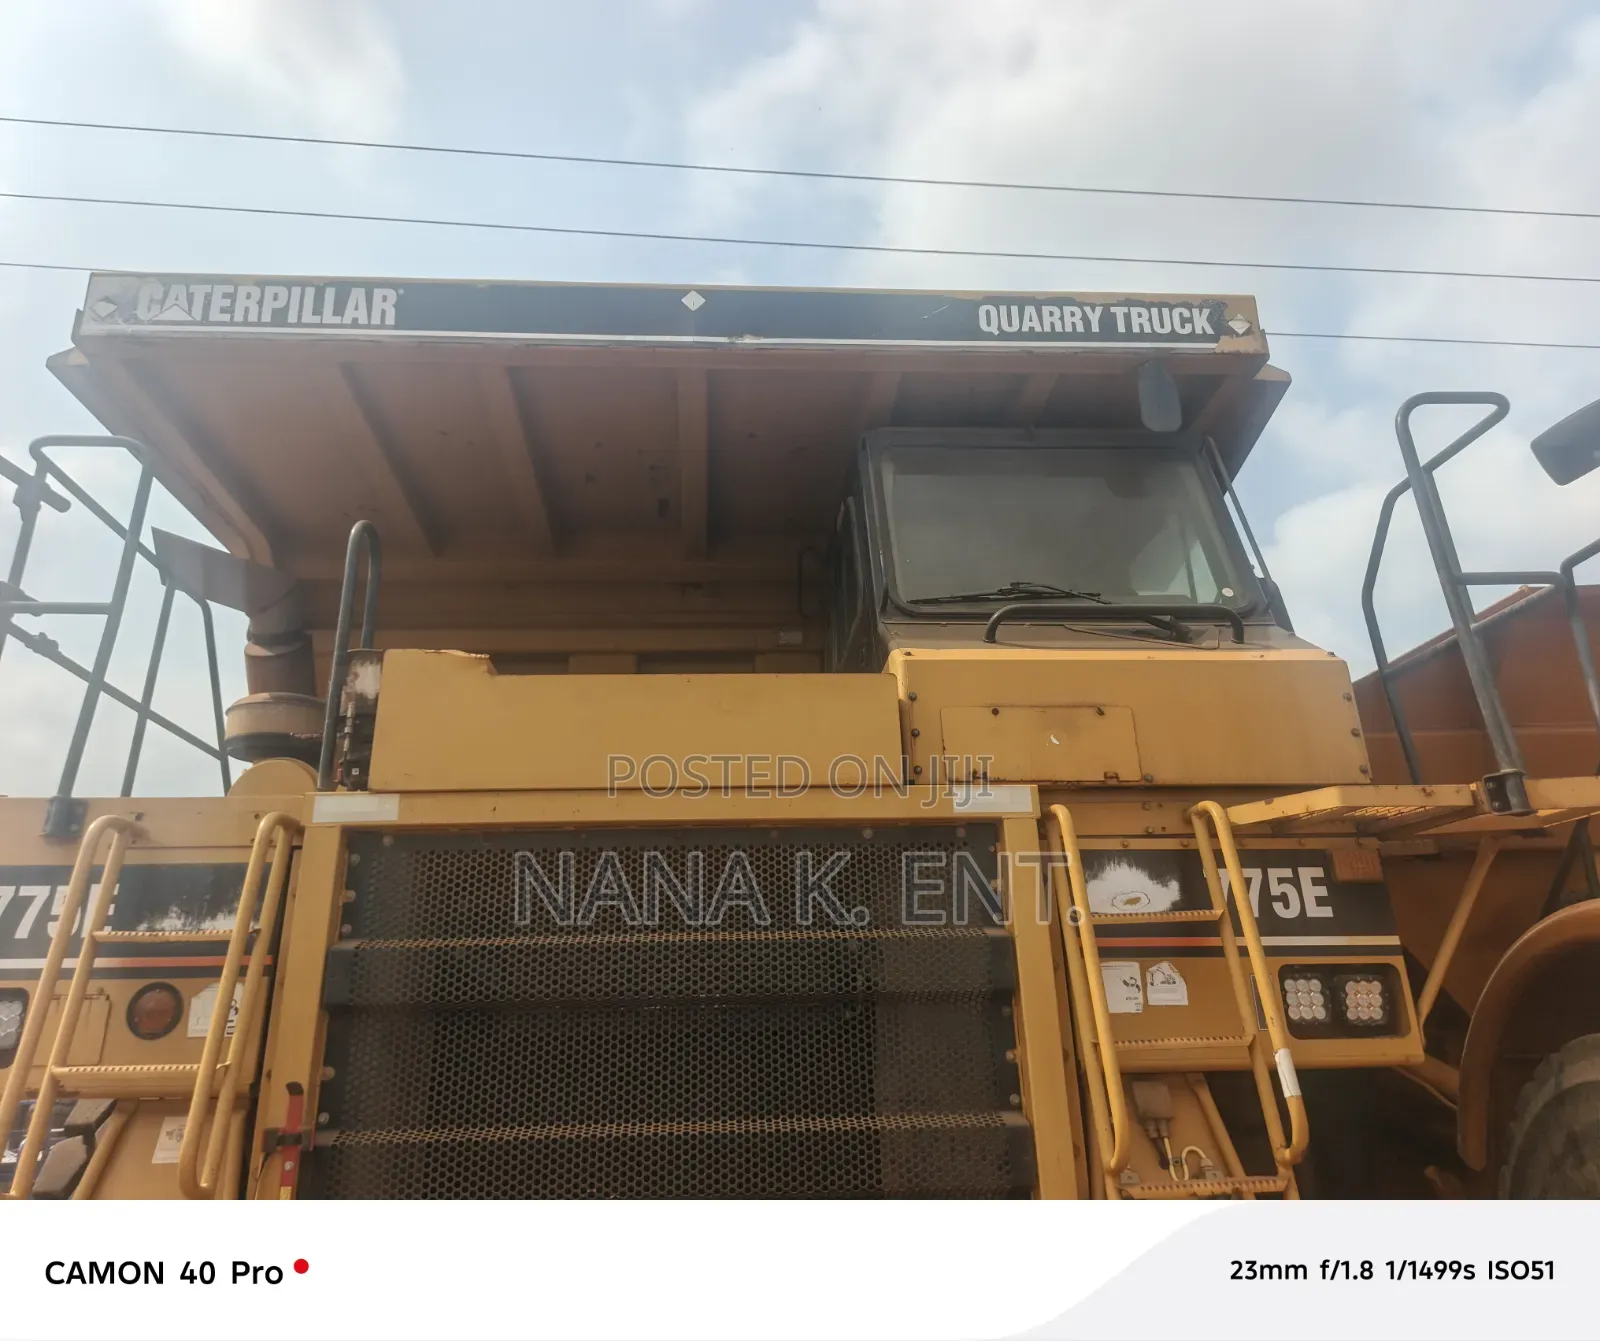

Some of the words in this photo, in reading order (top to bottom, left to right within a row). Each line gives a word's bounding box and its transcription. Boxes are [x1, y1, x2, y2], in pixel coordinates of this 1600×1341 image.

[136, 284, 396, 325] CATERPILLAR
[978, 304, 1103, 335] QUARRY
[1110, 306, 1214, 334] TRUCK
